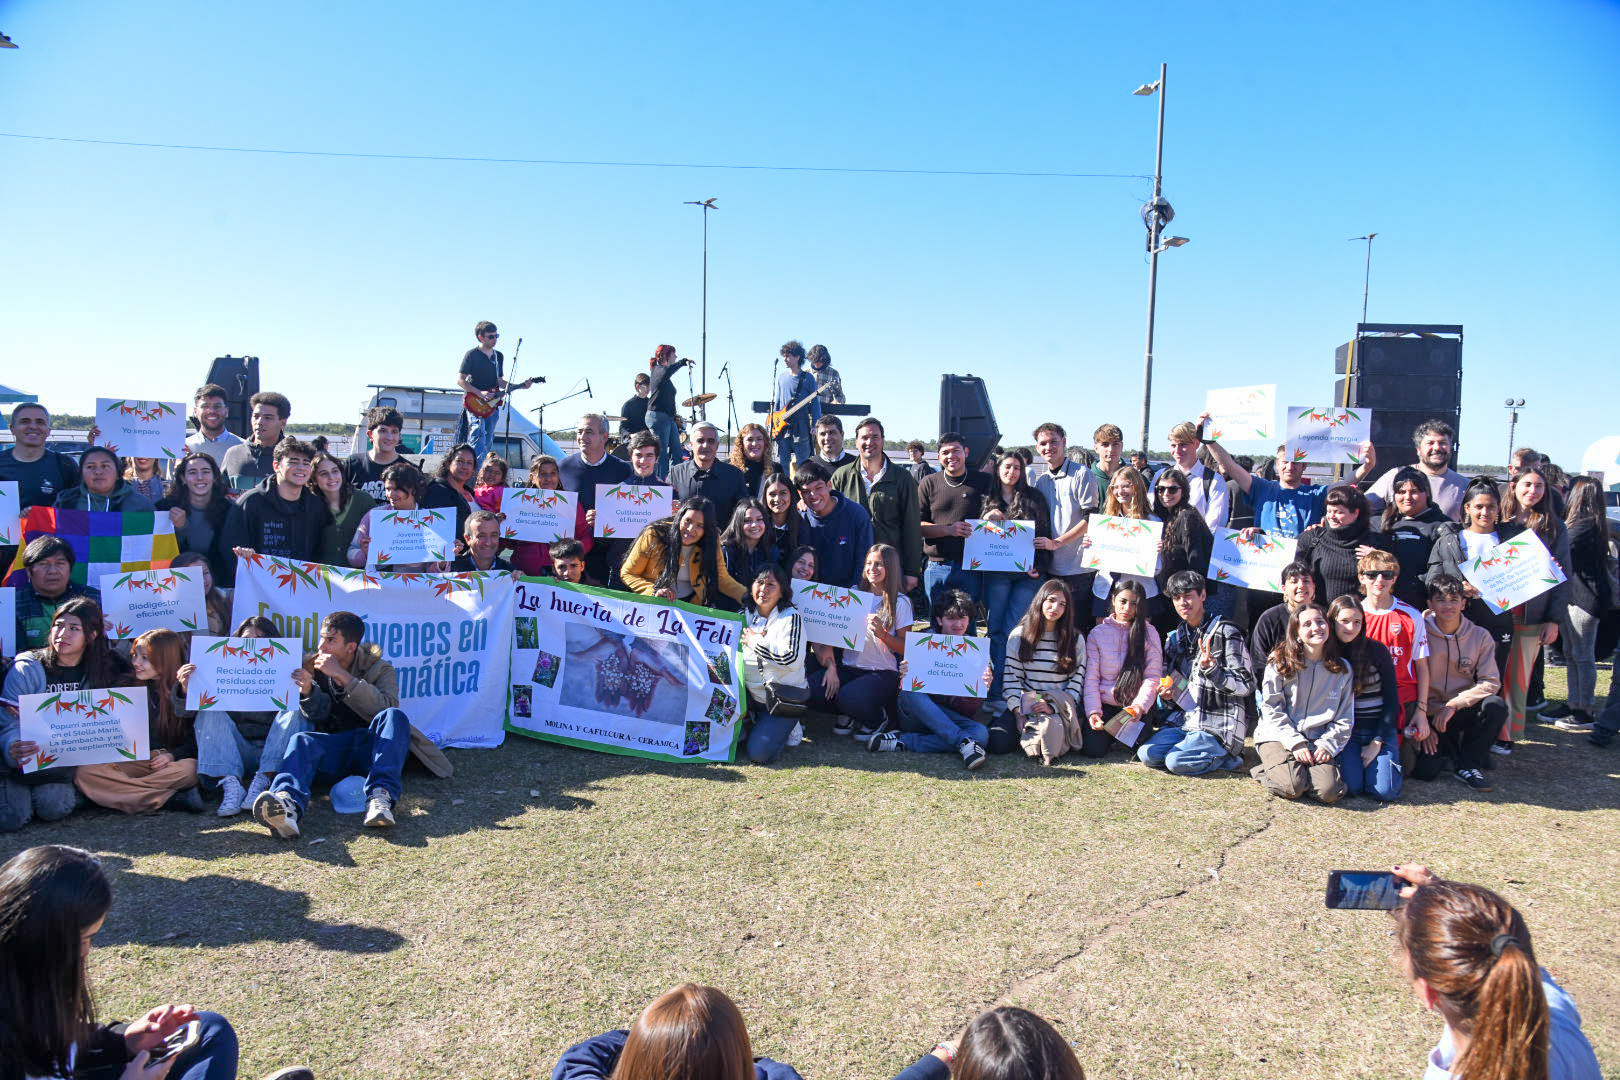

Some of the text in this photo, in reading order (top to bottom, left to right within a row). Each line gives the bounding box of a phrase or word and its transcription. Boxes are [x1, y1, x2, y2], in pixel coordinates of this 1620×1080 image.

[121, 427, 161, 436] Yo separo
[519, 510, 557, 519] Reciclando
[515, 518, 559, 527] descartables
[1223, 554, 1232, 562] La
[1233, 557, 1248, 566] vida
[128, 600, 180, 611] Biodigestor
[135, 609, 175, 619] eficiente
[516, 585, 733, 647] La huerta de La Feli
[803, 607, 828, 618] Barrio,
[828, 613, 843, 621] que
[803, 616, 849, 630] quiero verde
[258, 601, 488, 659] ond venes en
[216, 666, 277, 675] Reciclado de
[940, 669, 964, 678] futuro
[216, 677, 256, 685] residuos
[388, 656, 481, 700] mática
[217, 687, 274, 695] termofusión
[80, 719, 121, 728] ambiental
[73, 728, 97, 737] Stella
[544, 719, 573, 731] MOLINA
[582, 725, 632, 741] CAFULCURA
[637, 736, 680, 750] CERAMICA
[78, 741, 124, 751] septiembre
